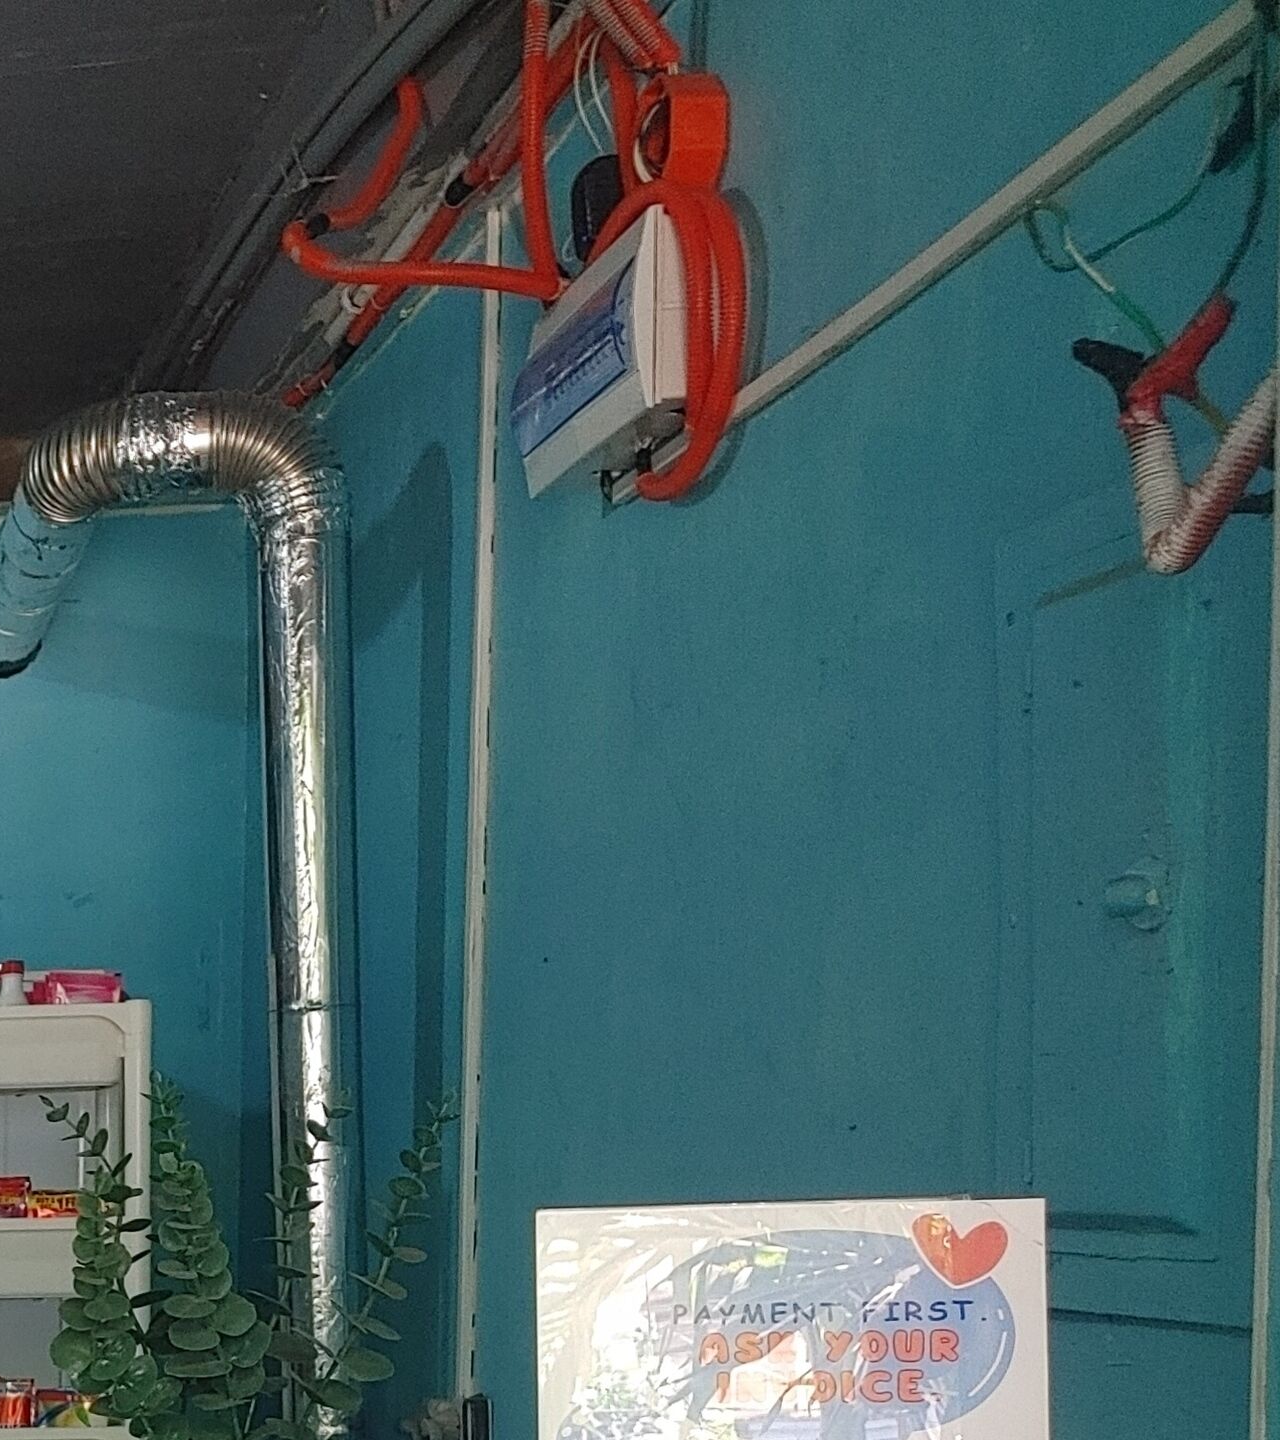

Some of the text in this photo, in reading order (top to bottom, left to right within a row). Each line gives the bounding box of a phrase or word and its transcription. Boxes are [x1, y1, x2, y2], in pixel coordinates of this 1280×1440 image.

[673, 1300, 987, 1326] PAYMENT FIRST.
[823, 1328, 960, 1364] YOUR
